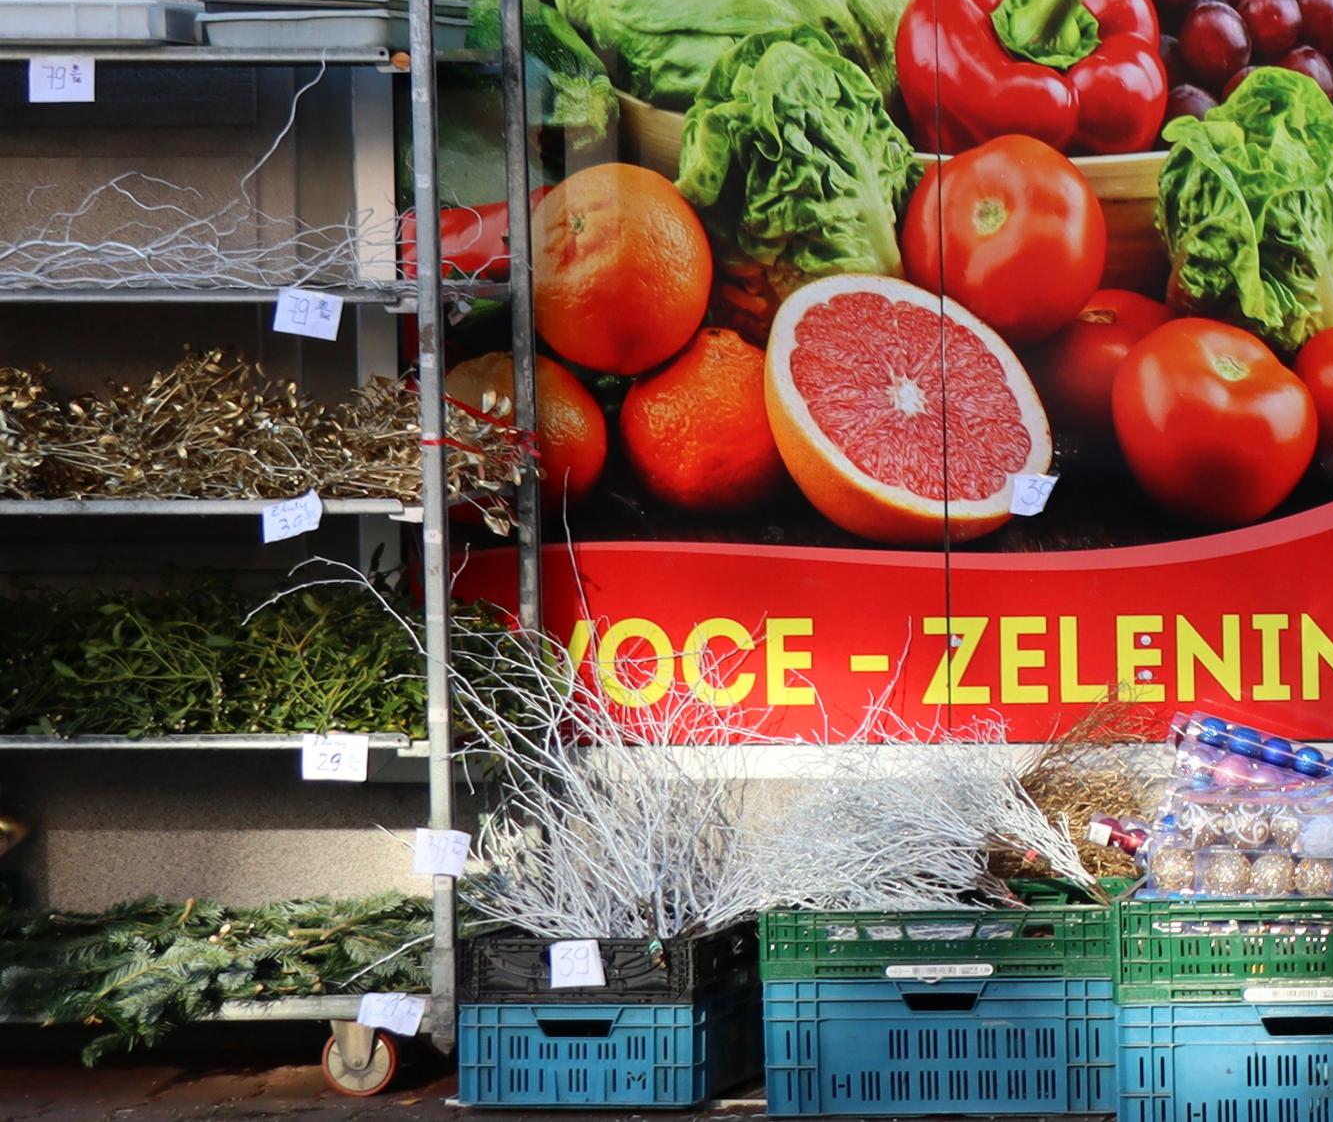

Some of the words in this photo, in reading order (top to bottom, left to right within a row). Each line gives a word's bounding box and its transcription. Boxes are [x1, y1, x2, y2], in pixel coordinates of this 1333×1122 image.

[42, 65, 66, 90] 79
[316, 752, 342, 772] 29
[559, 945, 590, 977] 39
